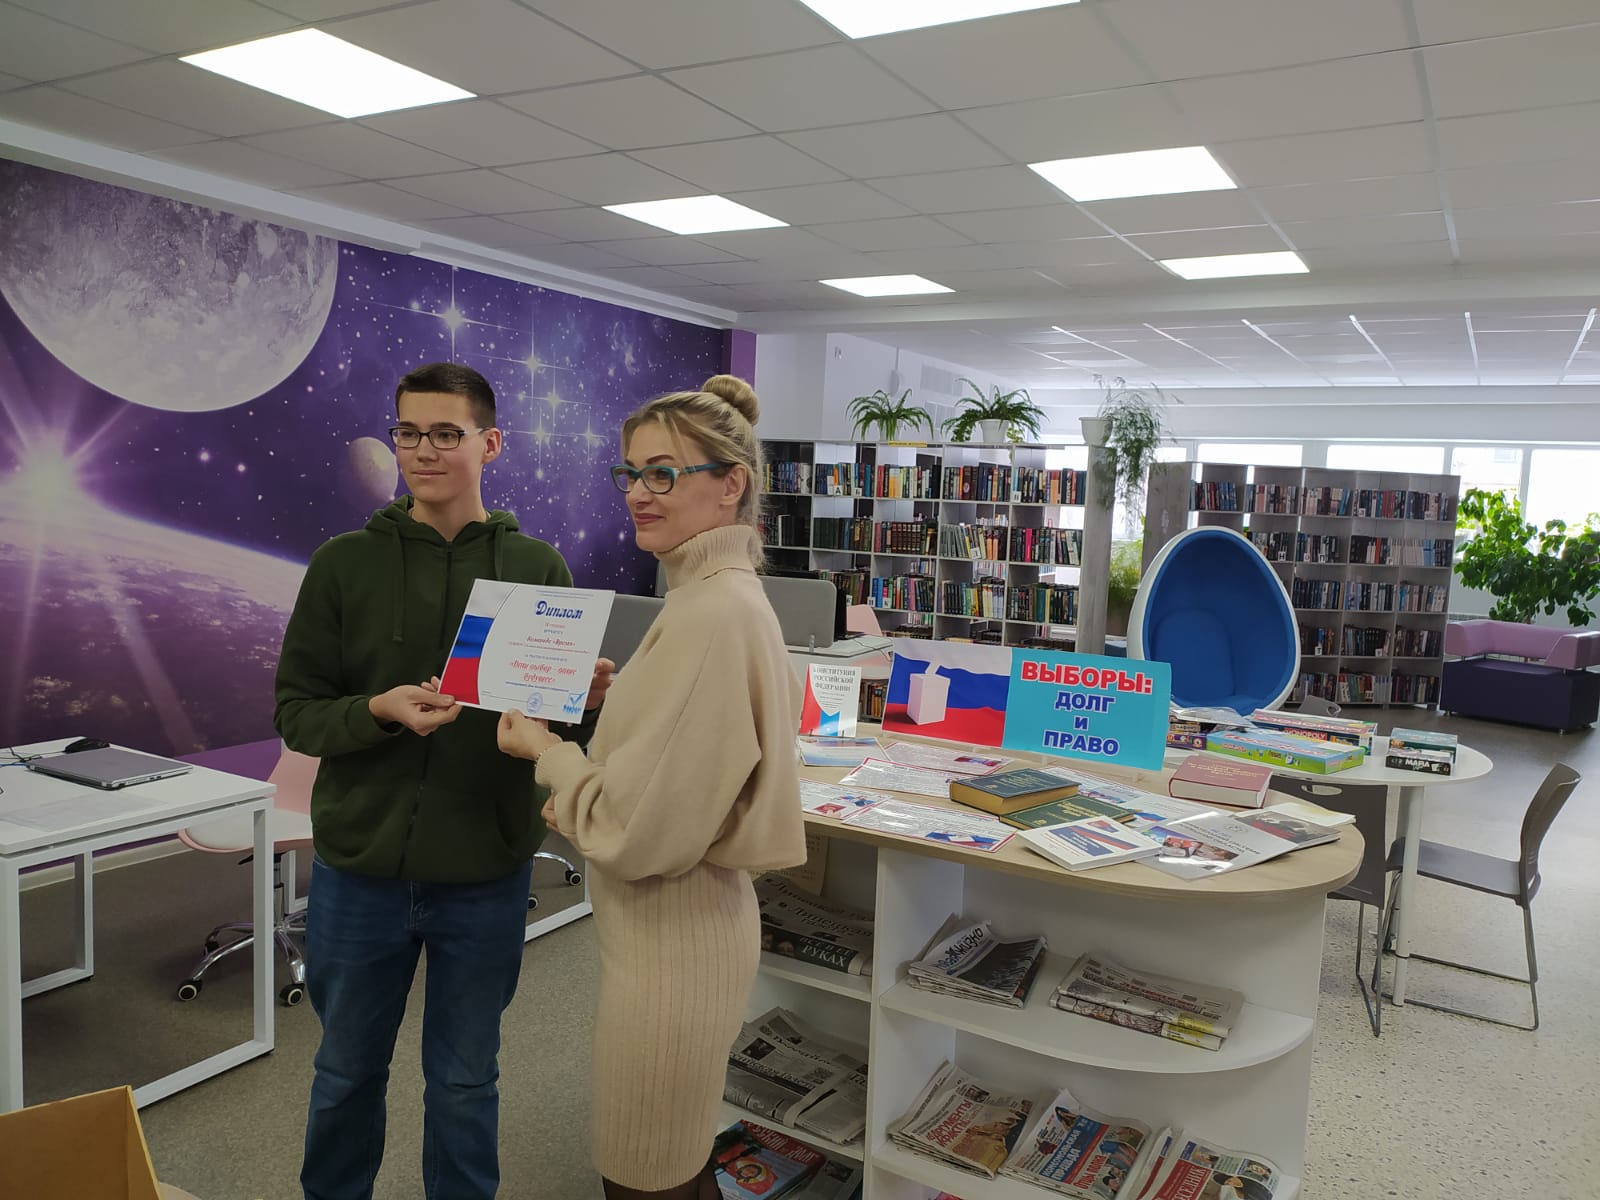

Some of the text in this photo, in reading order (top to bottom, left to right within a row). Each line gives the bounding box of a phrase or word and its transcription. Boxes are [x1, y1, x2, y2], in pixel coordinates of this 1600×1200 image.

[536, 600, 583, 619] Диплом
[1021, 661, 1153, 694] ВЫБОРЫ:
[1054, 691, 1116, 713] ДОЛГ
[1042, 730, 1120, 756] ПРАВО
[1405, 758, 1430, 768] MAFIA
[802, 944, 847, 967] РУКАХ
[925, 1099, 974, 1142] АРГУМЕНТЫ
[1041, 1129, 1081, 1177] КОМСОМОЛЬСКАЯ
[1050, 1147, 1081, 1181] ПРАВДА
